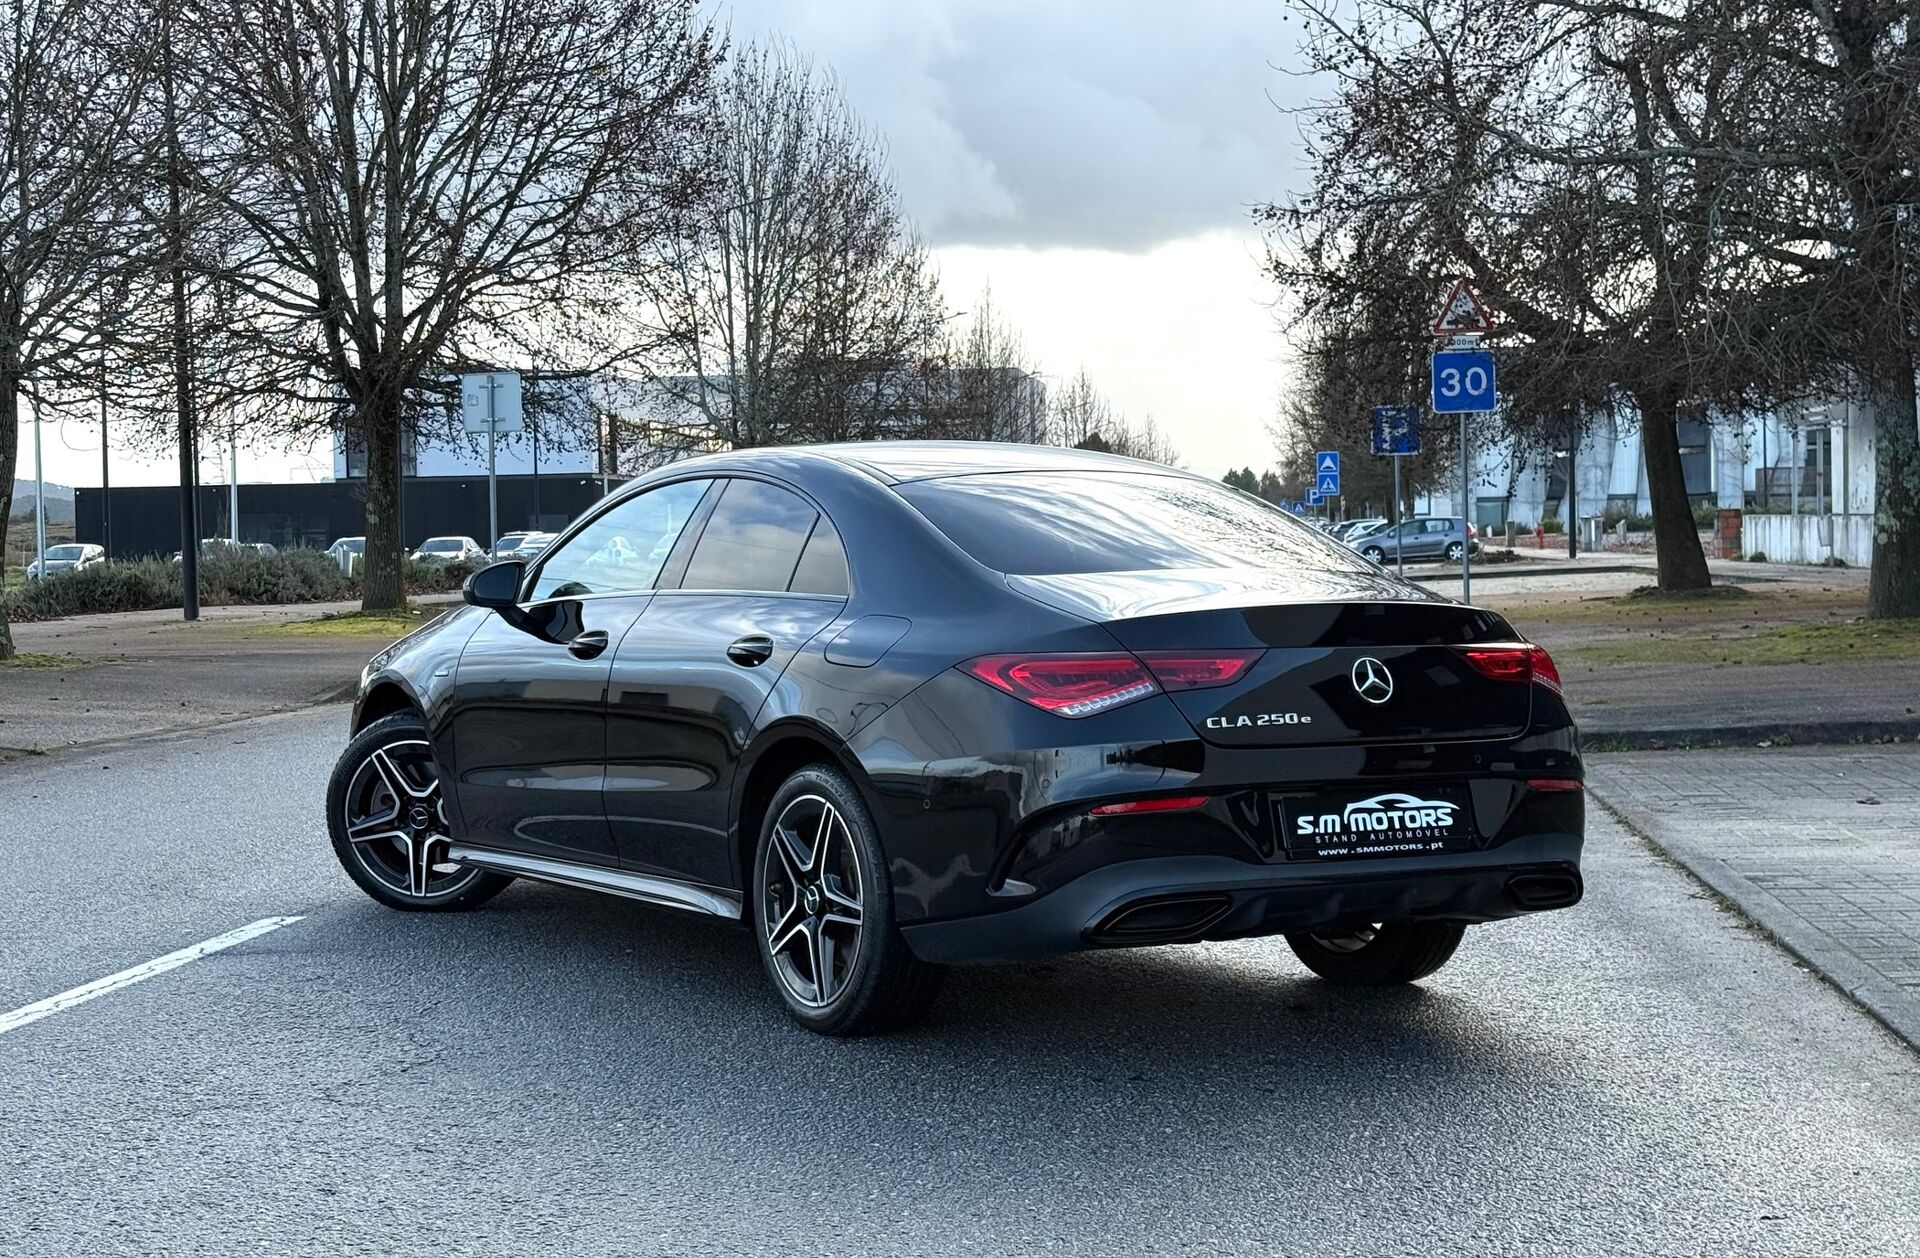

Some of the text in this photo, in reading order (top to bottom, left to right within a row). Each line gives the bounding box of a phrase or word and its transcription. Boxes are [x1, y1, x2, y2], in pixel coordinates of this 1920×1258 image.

[1441, 367, 1488, 397] 30
[1309, 490, 1320, 504] P
[1206, 713, 1312, 728] CLA 250e
[1297, 808, 1454, 834] S.M MOTORS
[1315, 834, 1357, 844] STAND
